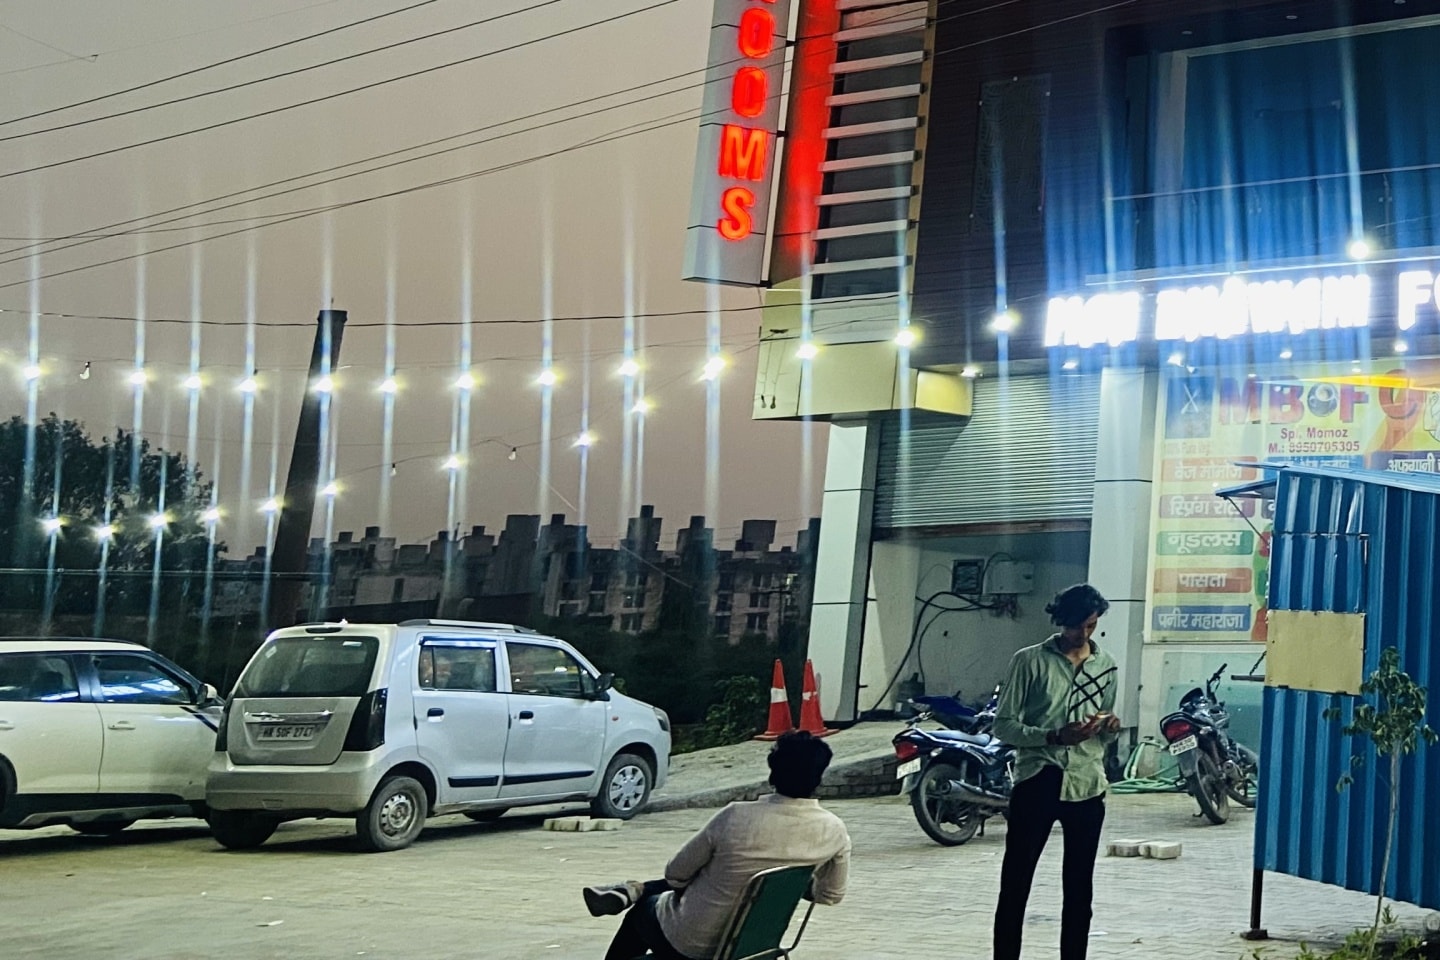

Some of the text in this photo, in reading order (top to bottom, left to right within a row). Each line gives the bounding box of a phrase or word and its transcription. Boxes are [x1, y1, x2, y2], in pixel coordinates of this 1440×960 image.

[1306, 426, 1349, 439] Momoz
[1158, 607, 1245, 630] पनीर महाराजा
